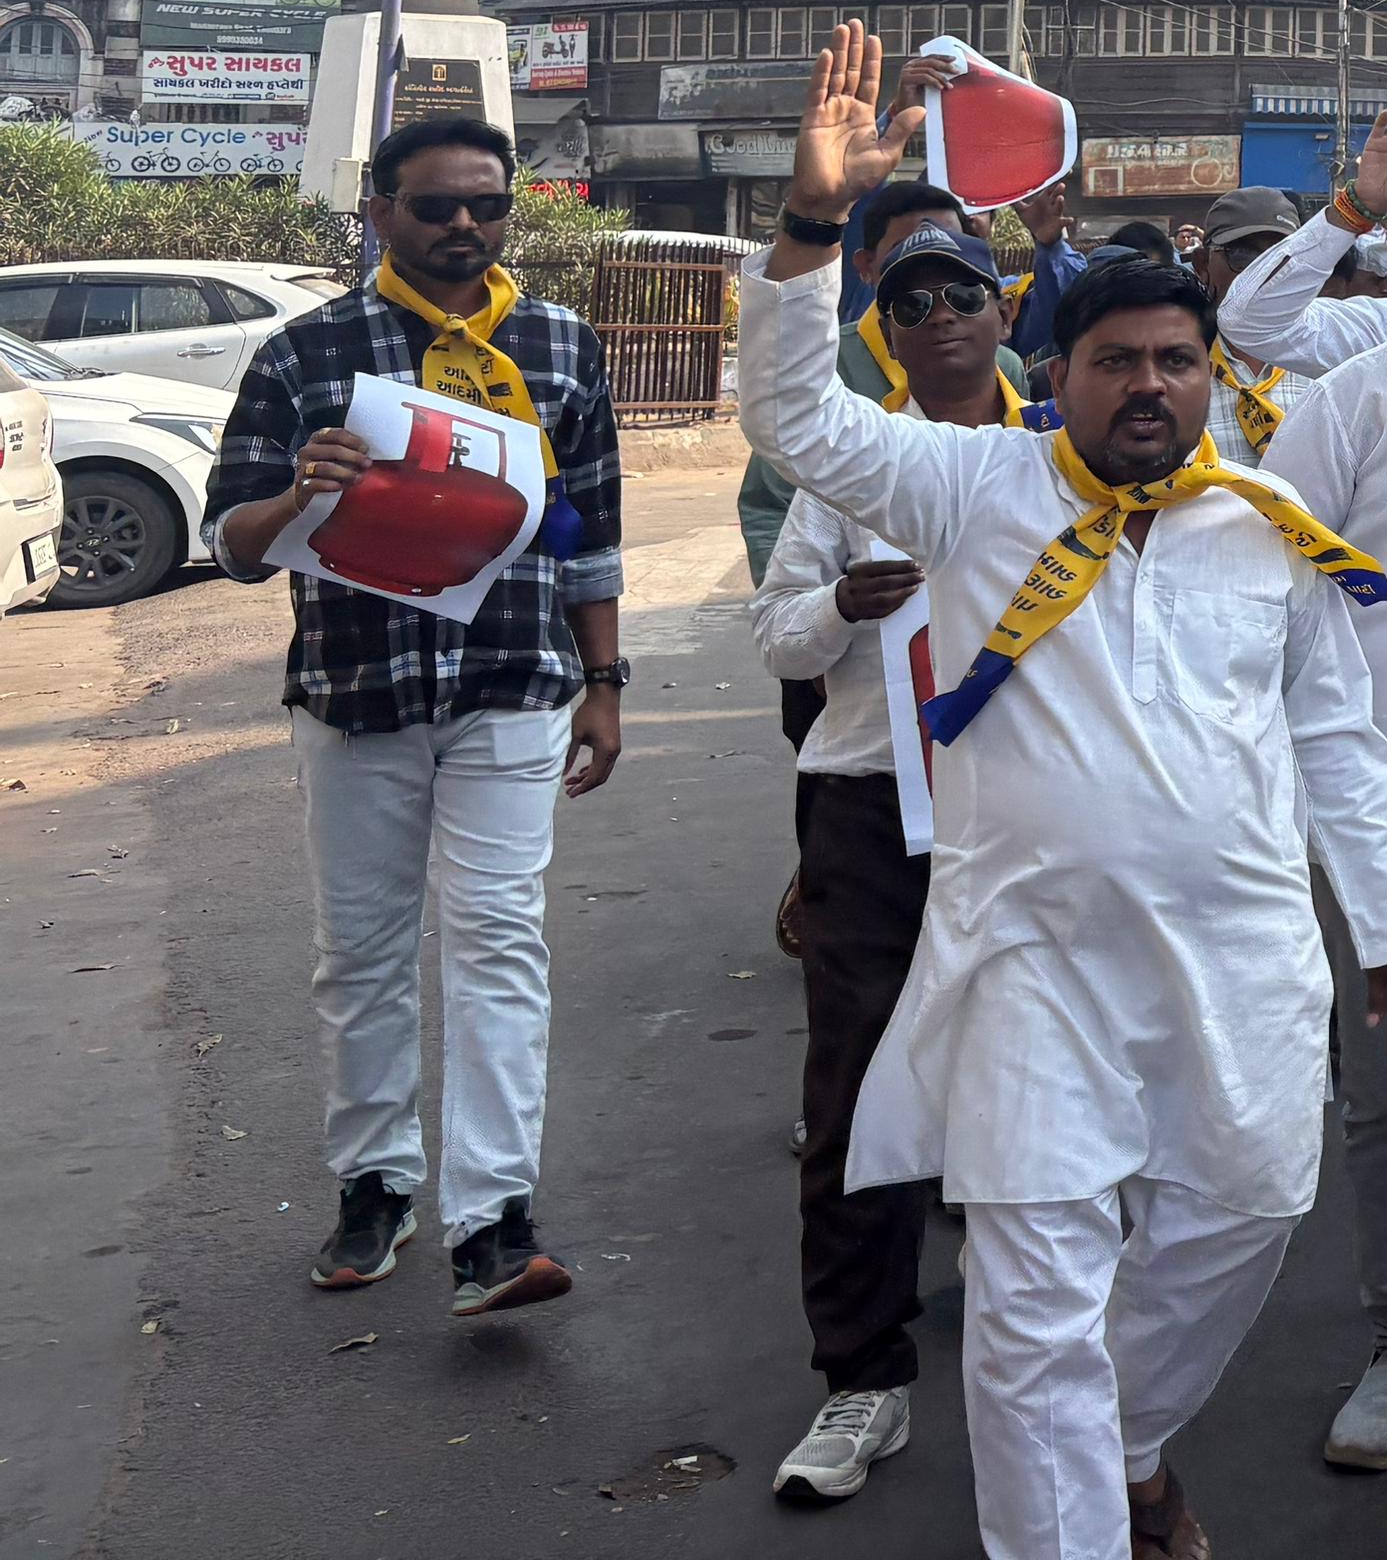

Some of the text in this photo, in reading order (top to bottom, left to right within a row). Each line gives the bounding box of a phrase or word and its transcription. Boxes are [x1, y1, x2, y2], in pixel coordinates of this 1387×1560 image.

[156, 3, 199, 16] NEW
[166, 55, 302, 77] સુપર સાયકલ
[106, 126, 174, 147] Super
[180, 127, 246, 147] Cycle
